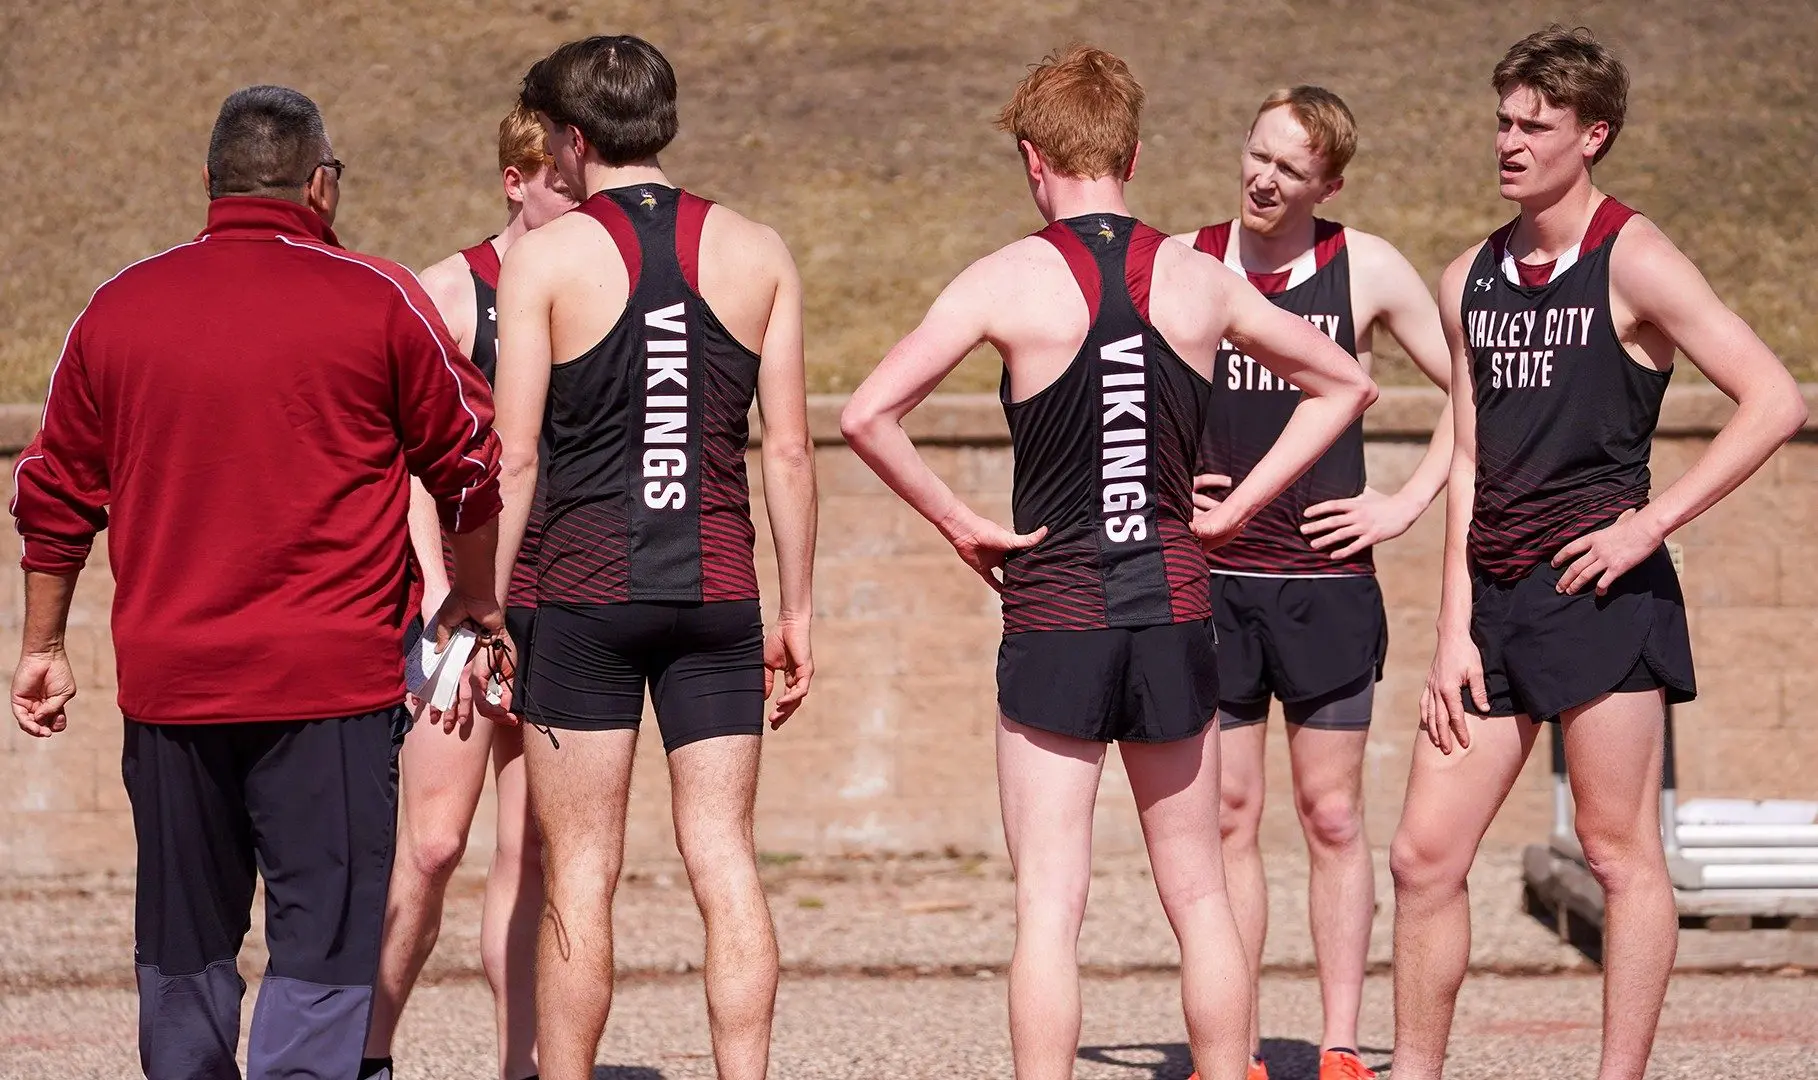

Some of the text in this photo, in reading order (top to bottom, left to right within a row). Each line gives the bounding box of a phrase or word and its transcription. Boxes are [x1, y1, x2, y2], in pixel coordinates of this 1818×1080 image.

[1468, 308, 1595, 347] VALLEY CITY
[1228, 354, 1300, 391] STA
[1492, 350, 1554, 389] STATE
[643, 302, 687, 509] VIKINGS
[1100, 333, 1147, 543] VIKINGS
